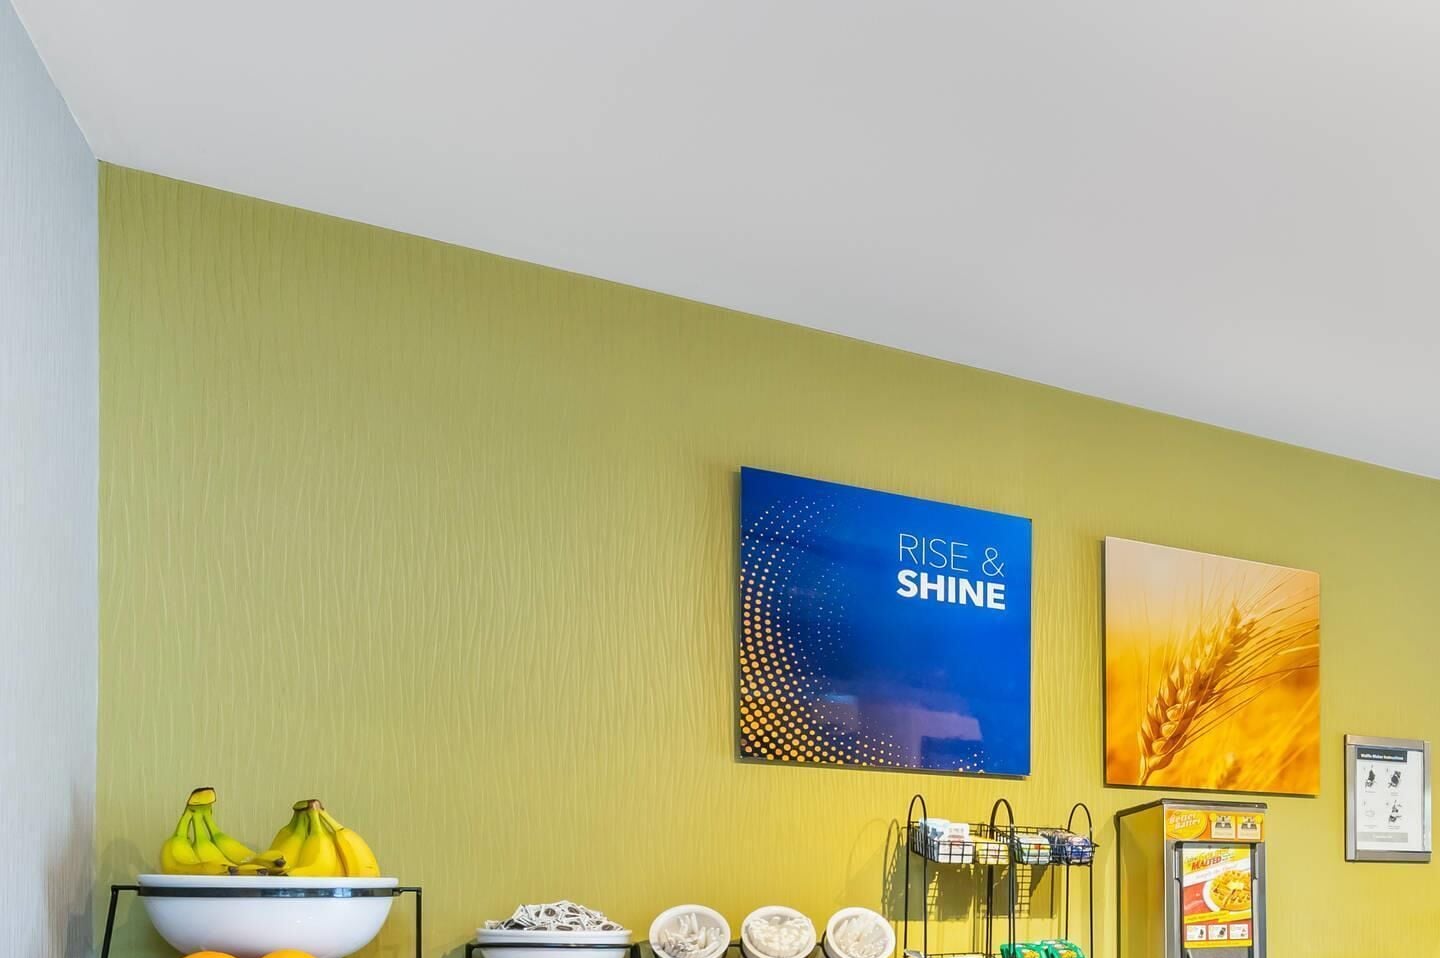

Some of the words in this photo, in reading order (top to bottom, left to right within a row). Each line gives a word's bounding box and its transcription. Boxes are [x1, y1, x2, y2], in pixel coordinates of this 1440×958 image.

[899, 533, 969, 572] RISE
[981, 547, 1005, 578] &
[896, 569, 1006, 610] SHINE
